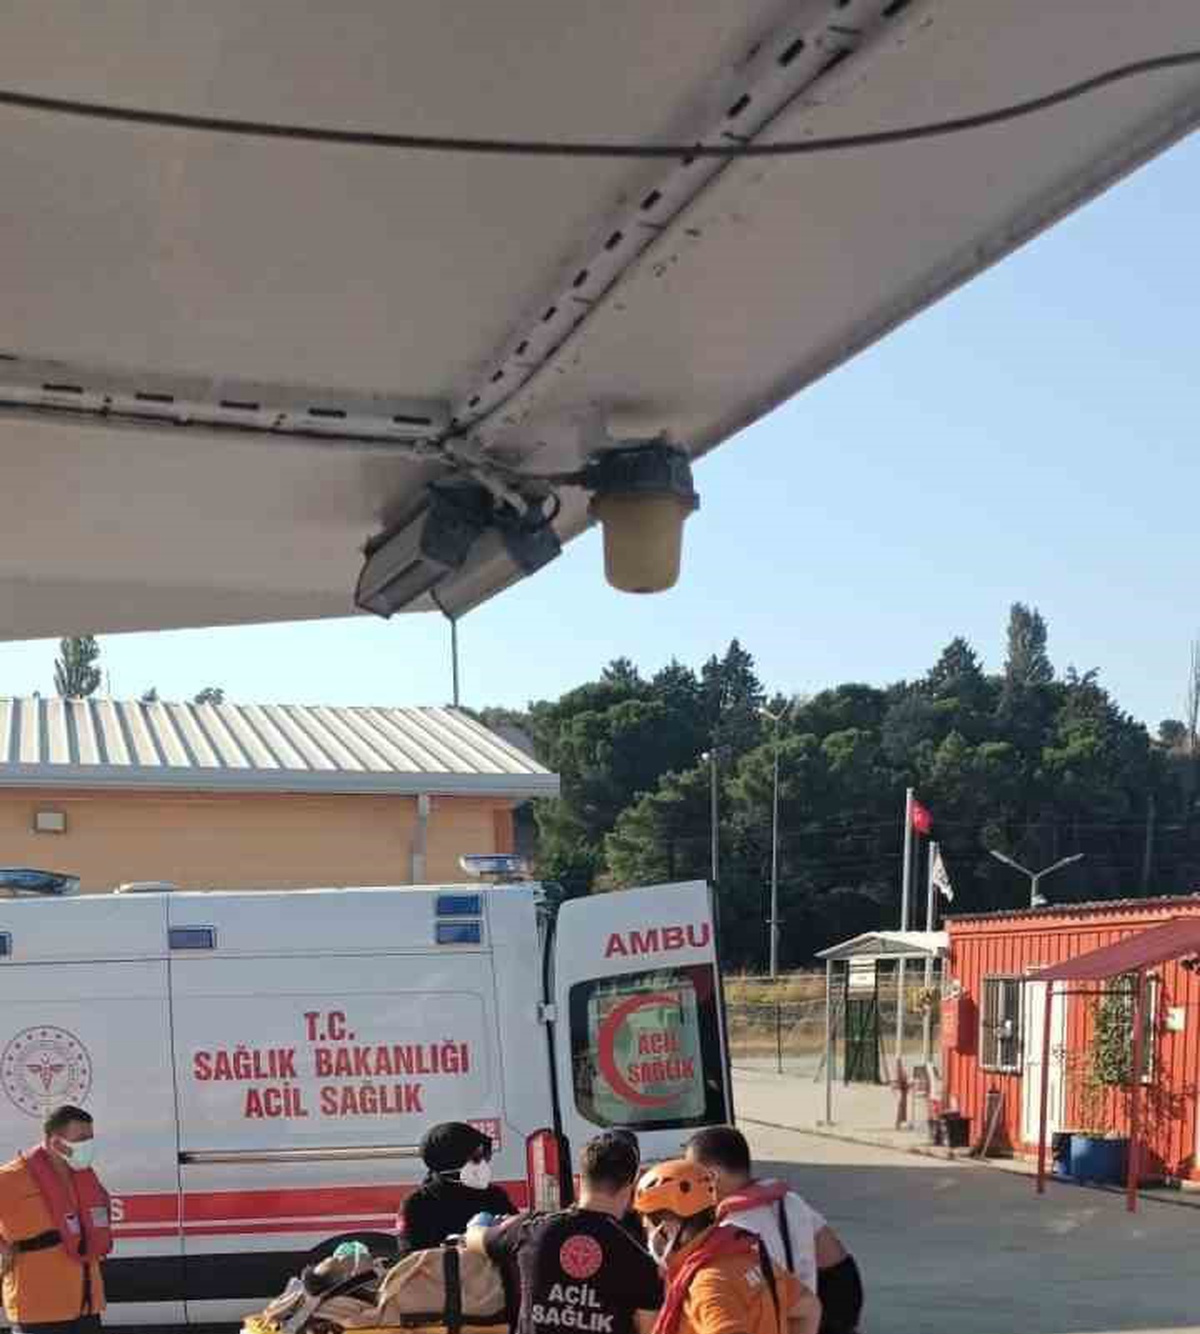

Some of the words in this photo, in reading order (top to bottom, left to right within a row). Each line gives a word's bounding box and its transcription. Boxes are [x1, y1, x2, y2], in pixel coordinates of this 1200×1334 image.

[605, 921, 711, 959] AMBU
[303, 1011, 355, 1041] T.C.
[193, 1045, 298, 1081] SAĞLIK
[314, 1038, 471, 1078] BAKANLIĞI
[244, 1082, 309, 1119] ACİL
[320, 1081, 424, 1117] SAĞLIK
[532, 1304, 614, 1334] SAĞLIK
